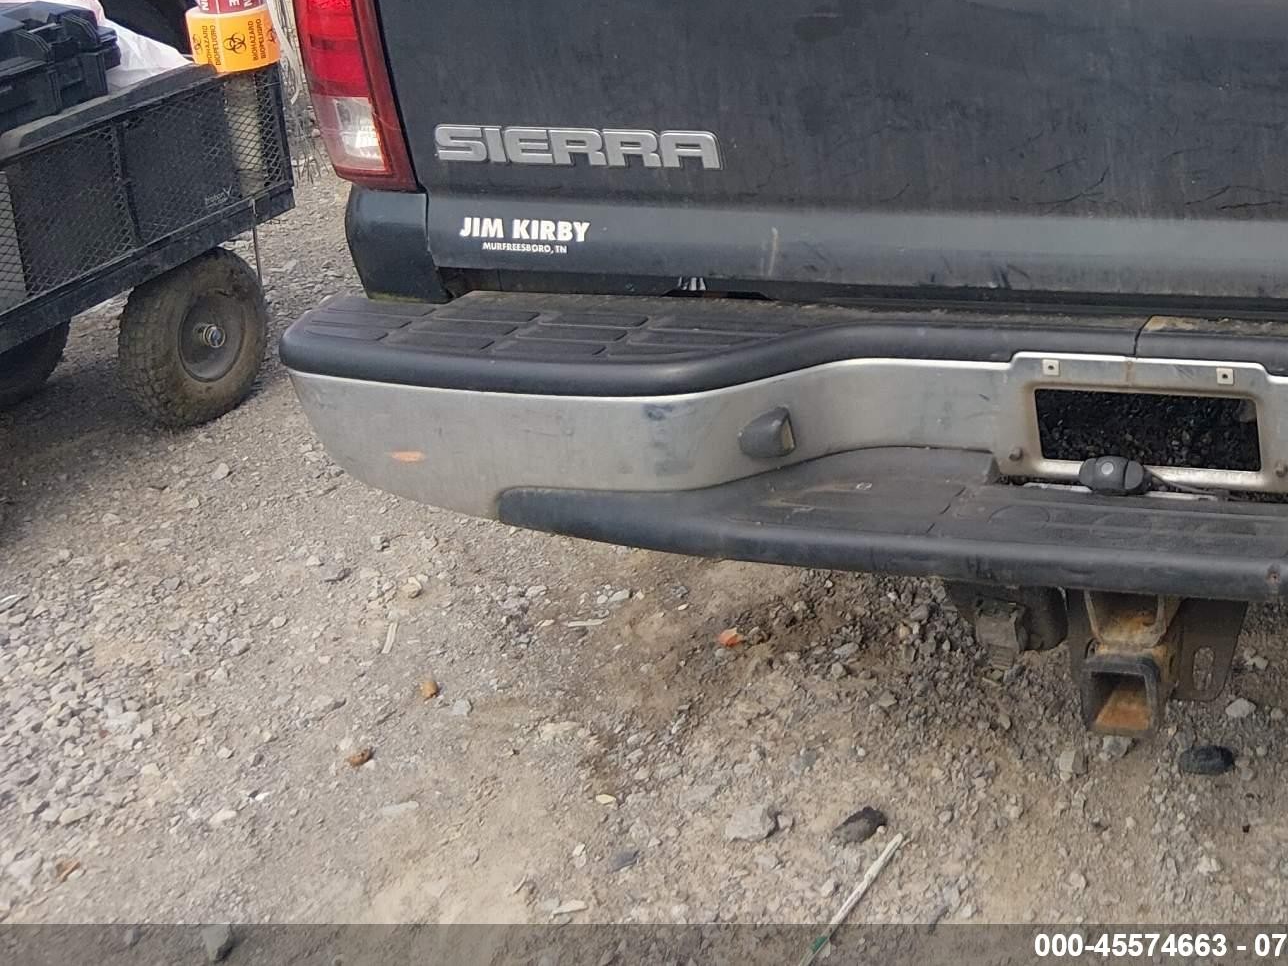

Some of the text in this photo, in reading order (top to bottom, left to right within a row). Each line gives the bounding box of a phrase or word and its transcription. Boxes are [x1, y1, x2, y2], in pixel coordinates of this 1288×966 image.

[200, 0, 210, 11] IN
[435, 124, 723, 170] SIERRA
[460, 217, 591, 242] JIM KIRBY
[482, 242, 567, 254] MURFREESBORO, TN
